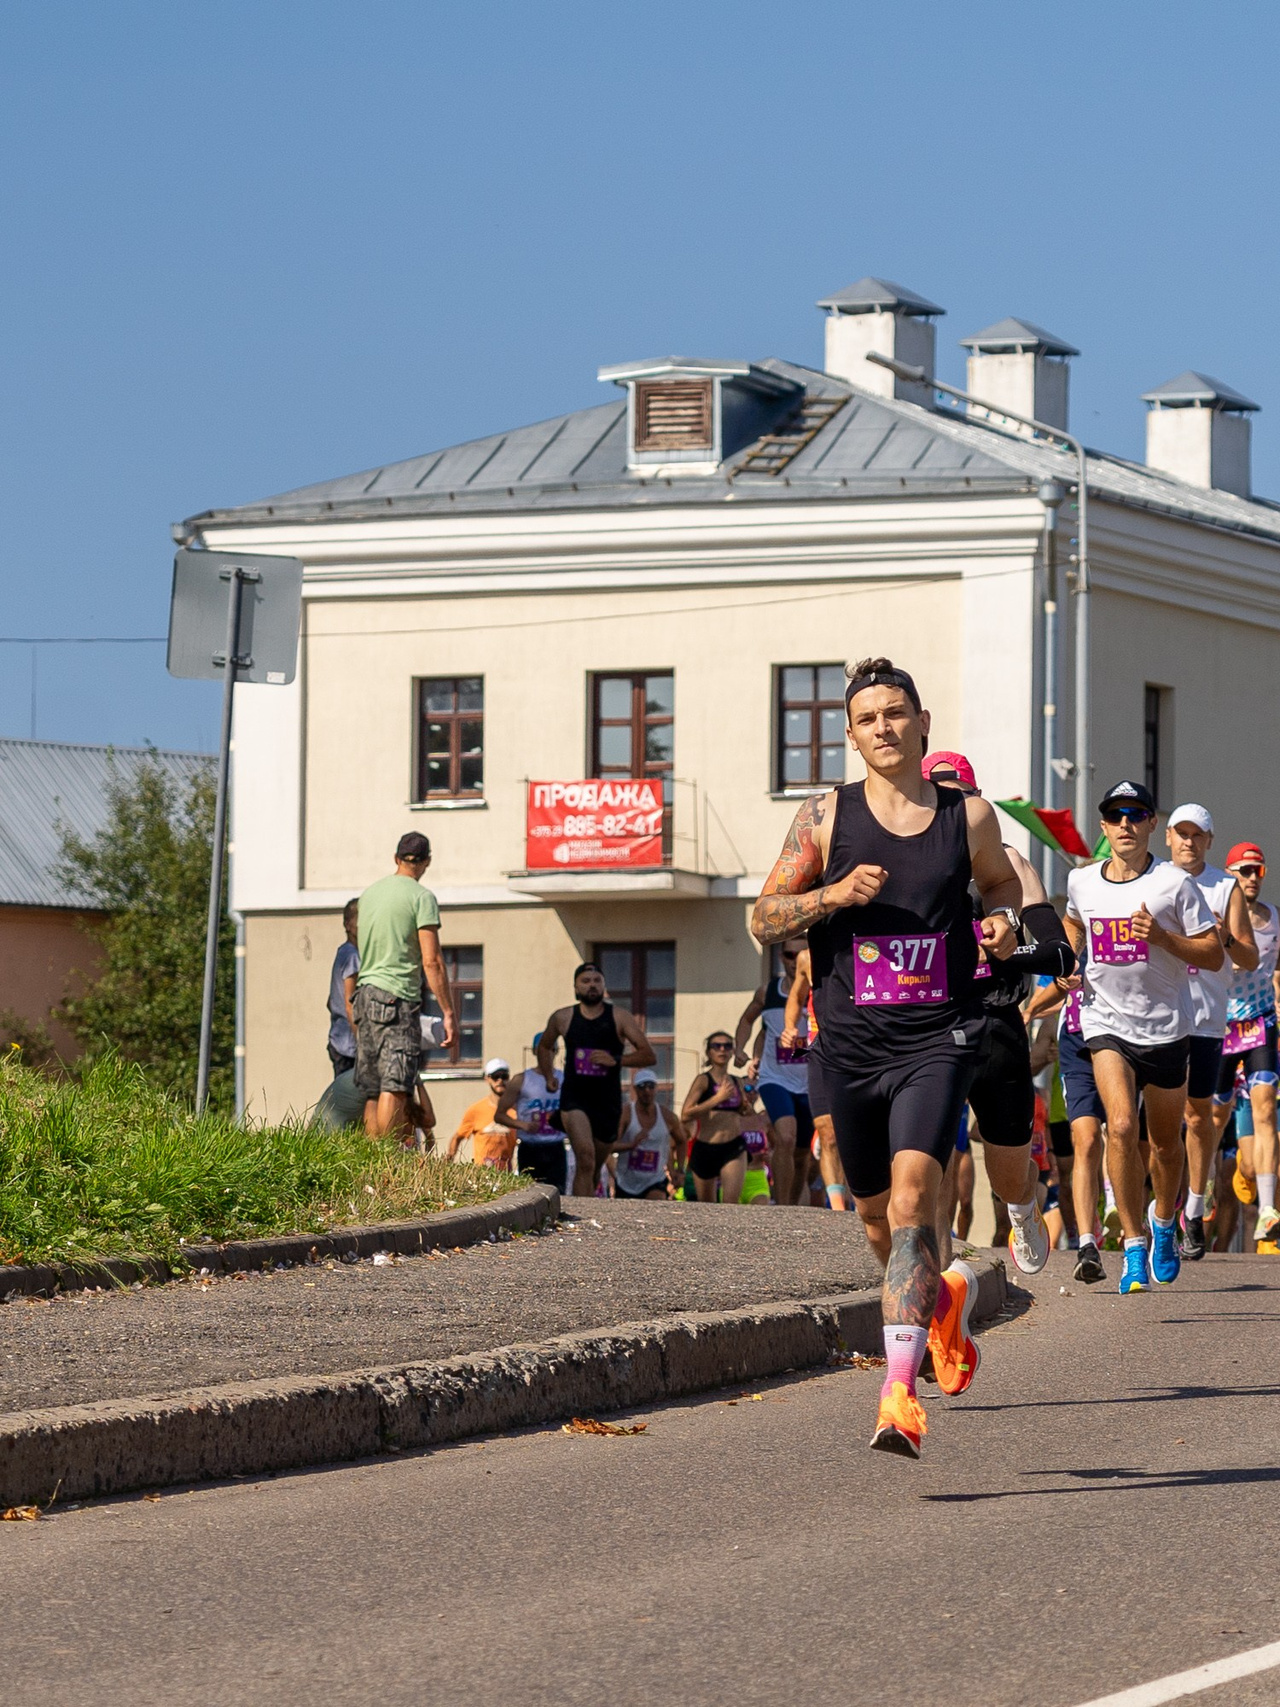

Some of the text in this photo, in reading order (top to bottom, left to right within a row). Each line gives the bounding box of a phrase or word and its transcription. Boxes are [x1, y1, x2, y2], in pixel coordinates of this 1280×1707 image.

[534, 783, 657, 811] ПРОДАЖА
[889, 938, 937, 972] 377
[897, 974, 930, 986] Кирилл
